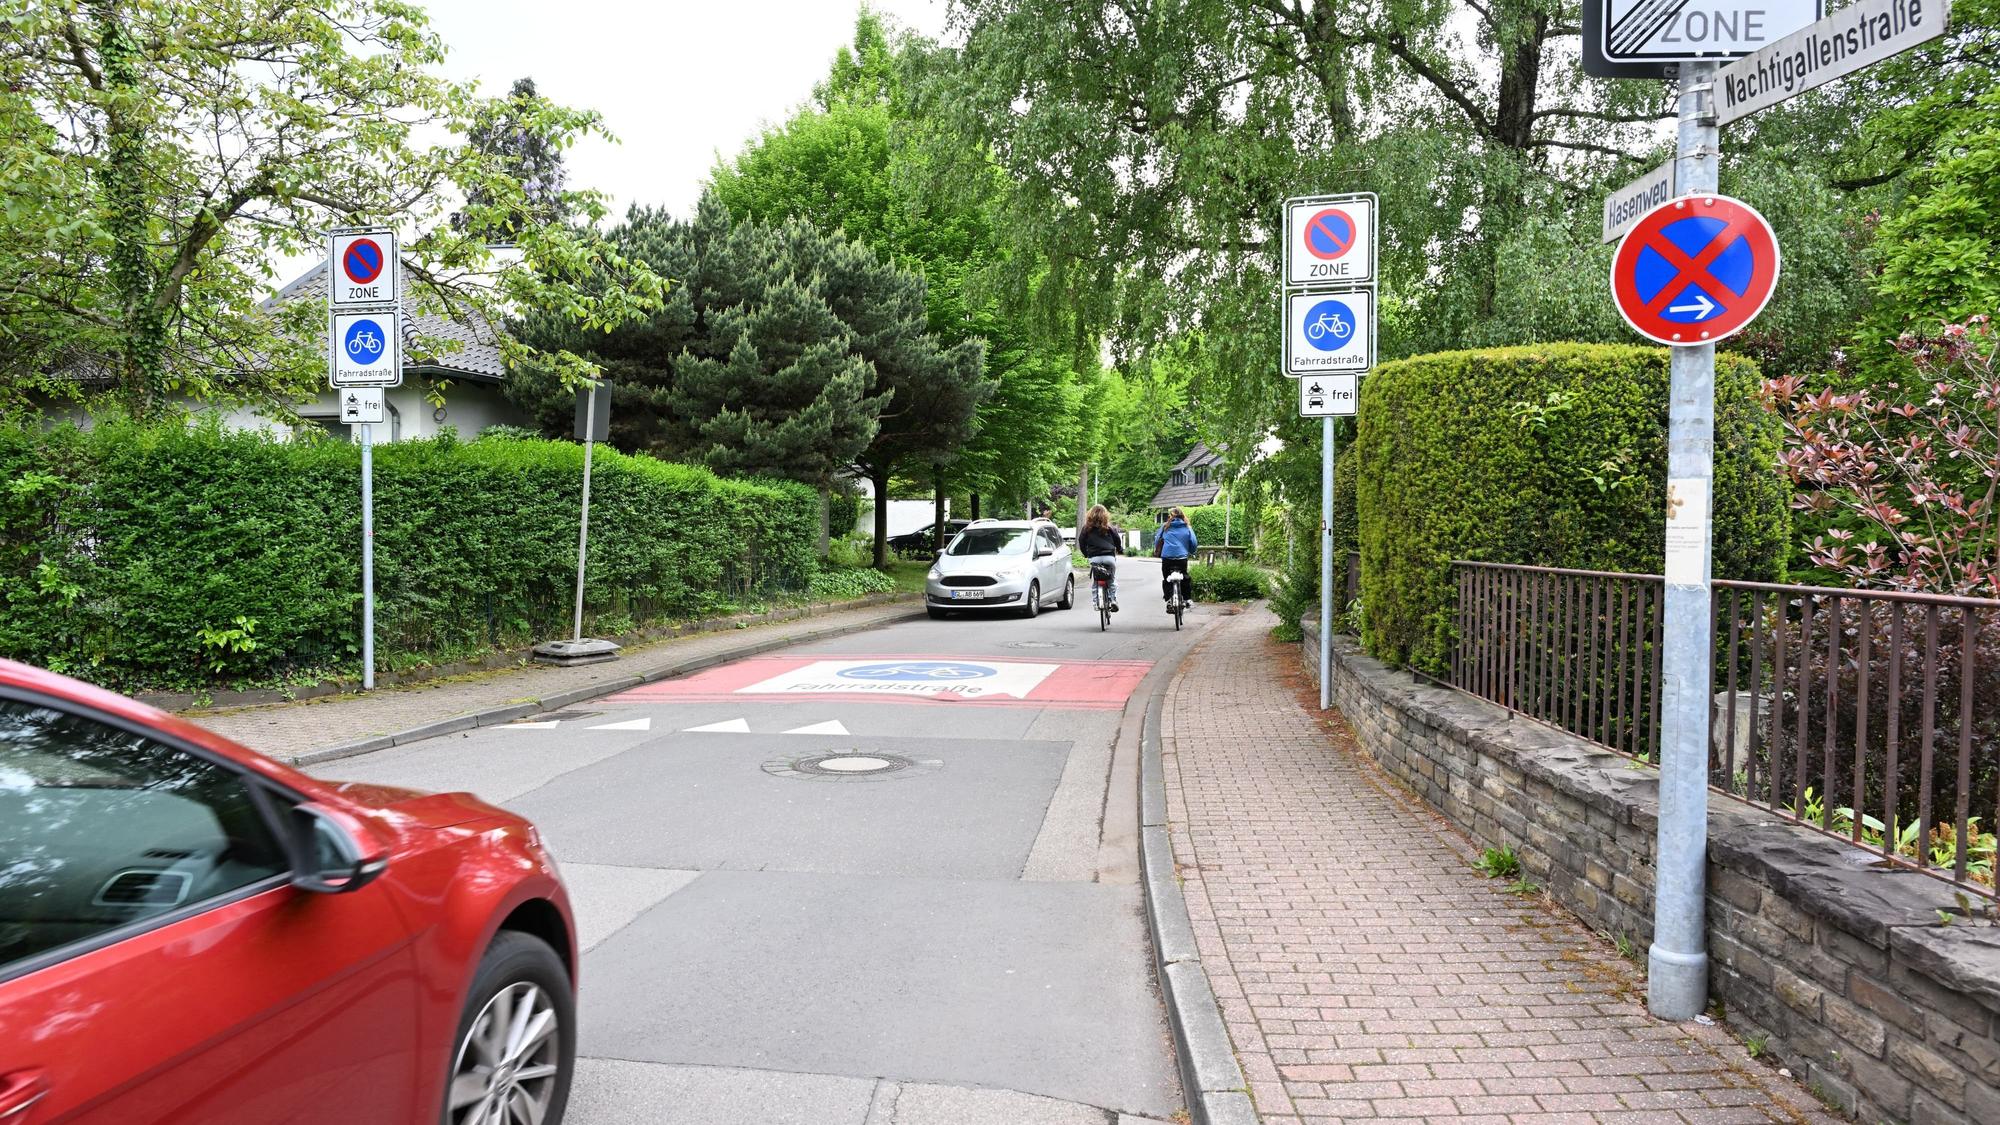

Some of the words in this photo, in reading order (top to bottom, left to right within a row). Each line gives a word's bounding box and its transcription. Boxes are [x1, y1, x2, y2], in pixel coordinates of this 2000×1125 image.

[1661, 10, 1766, 42] ZONE
[1725, 0, 1922, 108] Nachtigallenstraße
[1609, 179, 1667, 229] Hasenweg
[1310, 263, 1349, 277] ZONE
[348, 286, 379, 299] ZONE
[1294, 355, 1364, 366] Fahrradstraße
[338, 369, 392, 377] Fahrradstraße
[1332, 390, 1352, 399] frei
[364, 400, 380, 409] frei
[787, 683, 983, 694] Fahrradstraße
